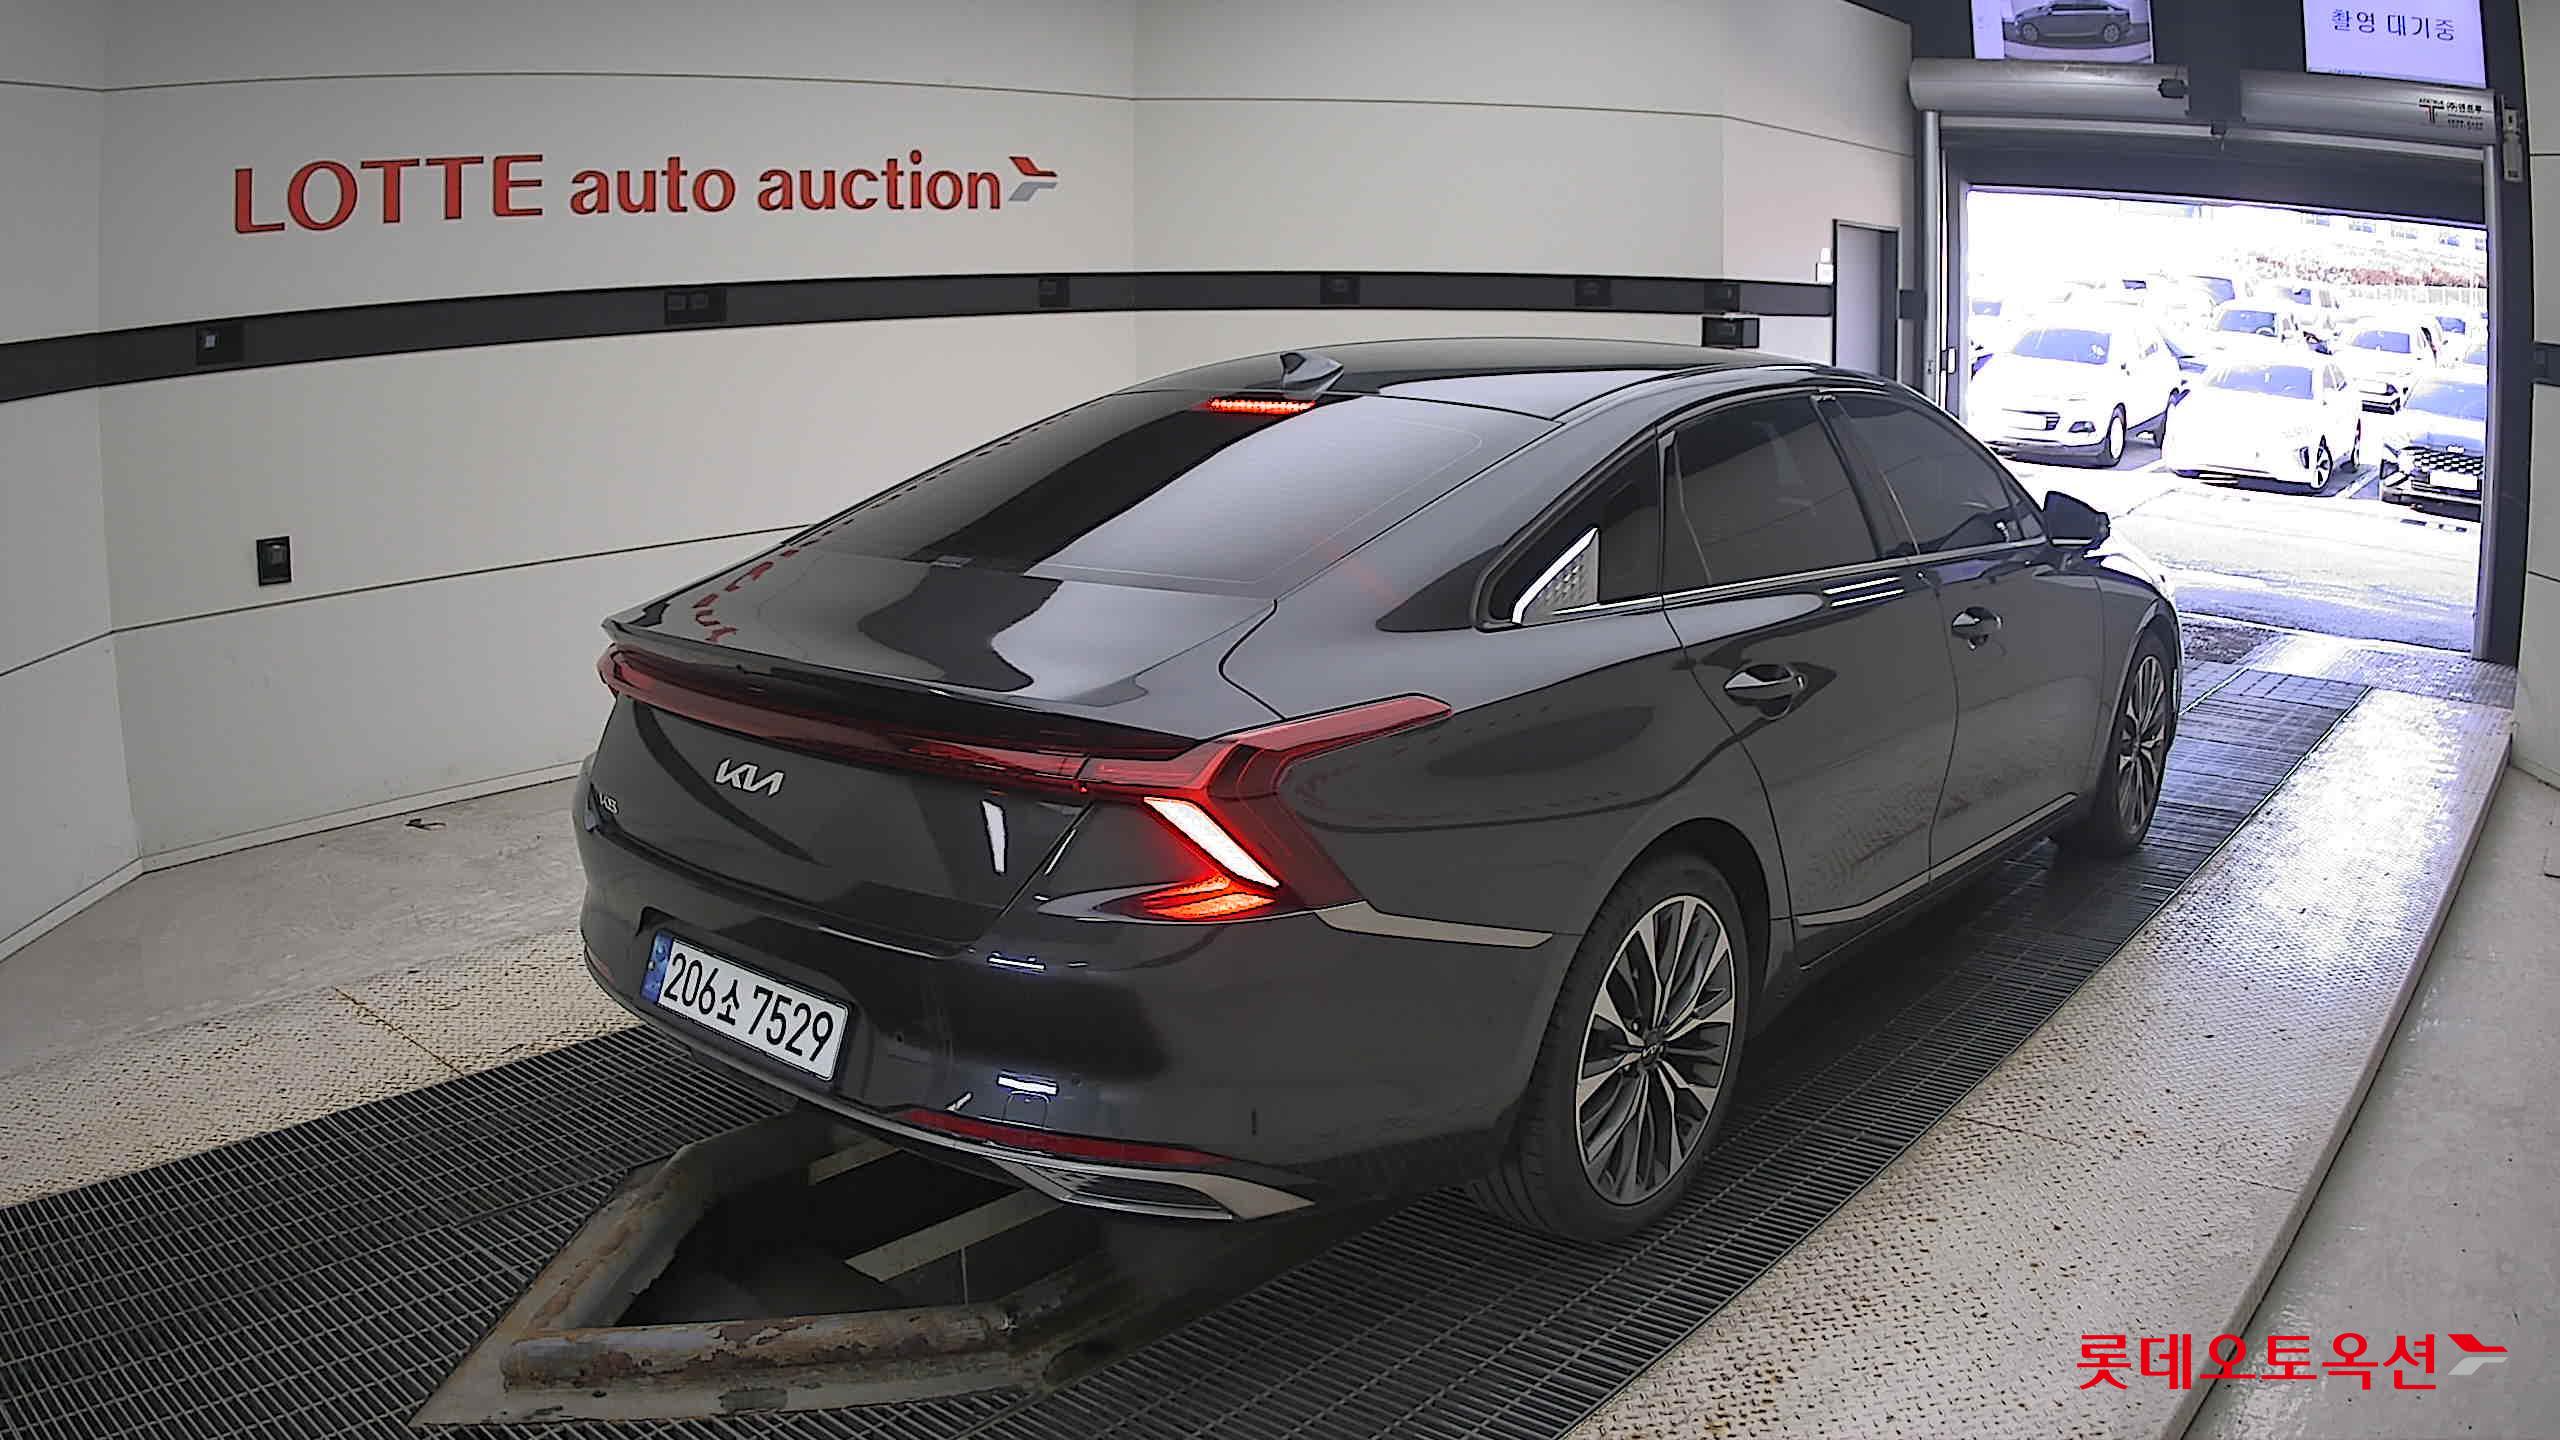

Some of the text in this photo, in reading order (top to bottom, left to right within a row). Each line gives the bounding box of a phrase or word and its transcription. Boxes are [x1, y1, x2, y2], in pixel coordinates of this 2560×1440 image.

[2387, 14, 2455, 41] 대기중
[235, 150, 1001, 234] LOTTE auto auction
[714, 758, 785, 797] KIA
[663, 952, 834, 1063] 206소 7529
